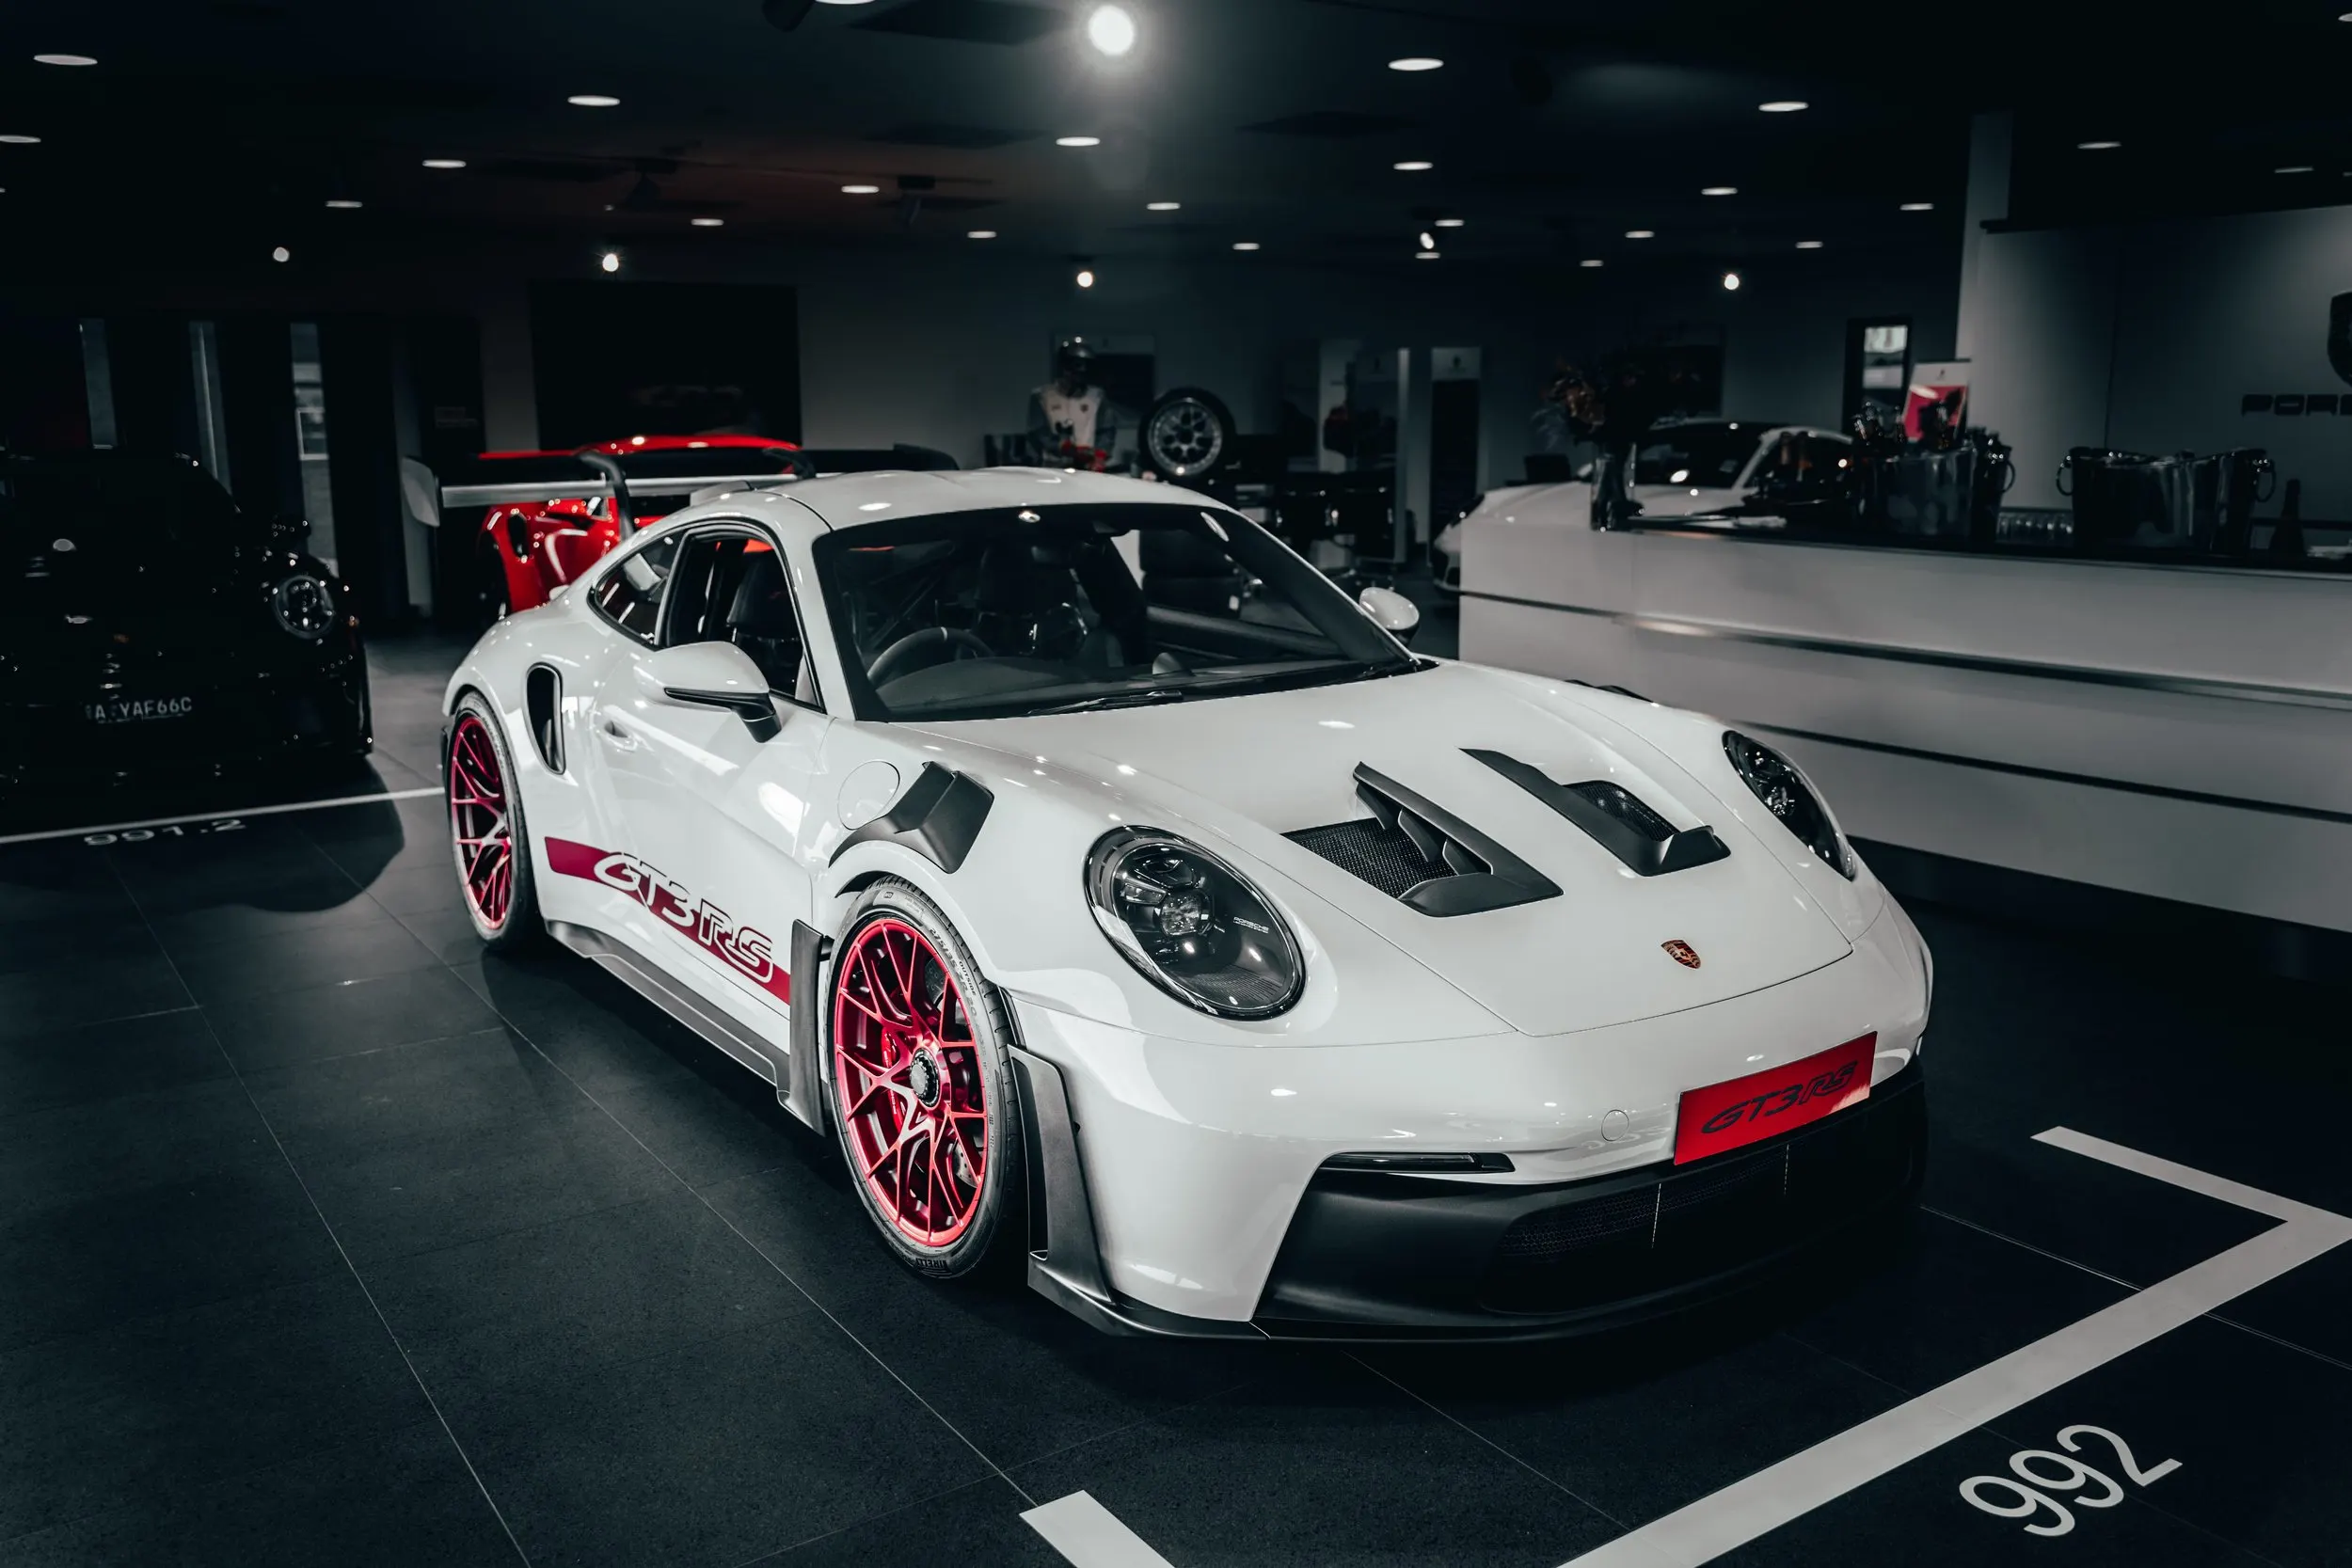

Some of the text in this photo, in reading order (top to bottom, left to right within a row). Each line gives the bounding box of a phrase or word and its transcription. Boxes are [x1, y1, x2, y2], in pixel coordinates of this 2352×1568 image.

[84, 818, 246, 846] 991.2
[958, 960, 977, 996] OUTSIDE
[1959, 1424, 2184, 1537] 992
